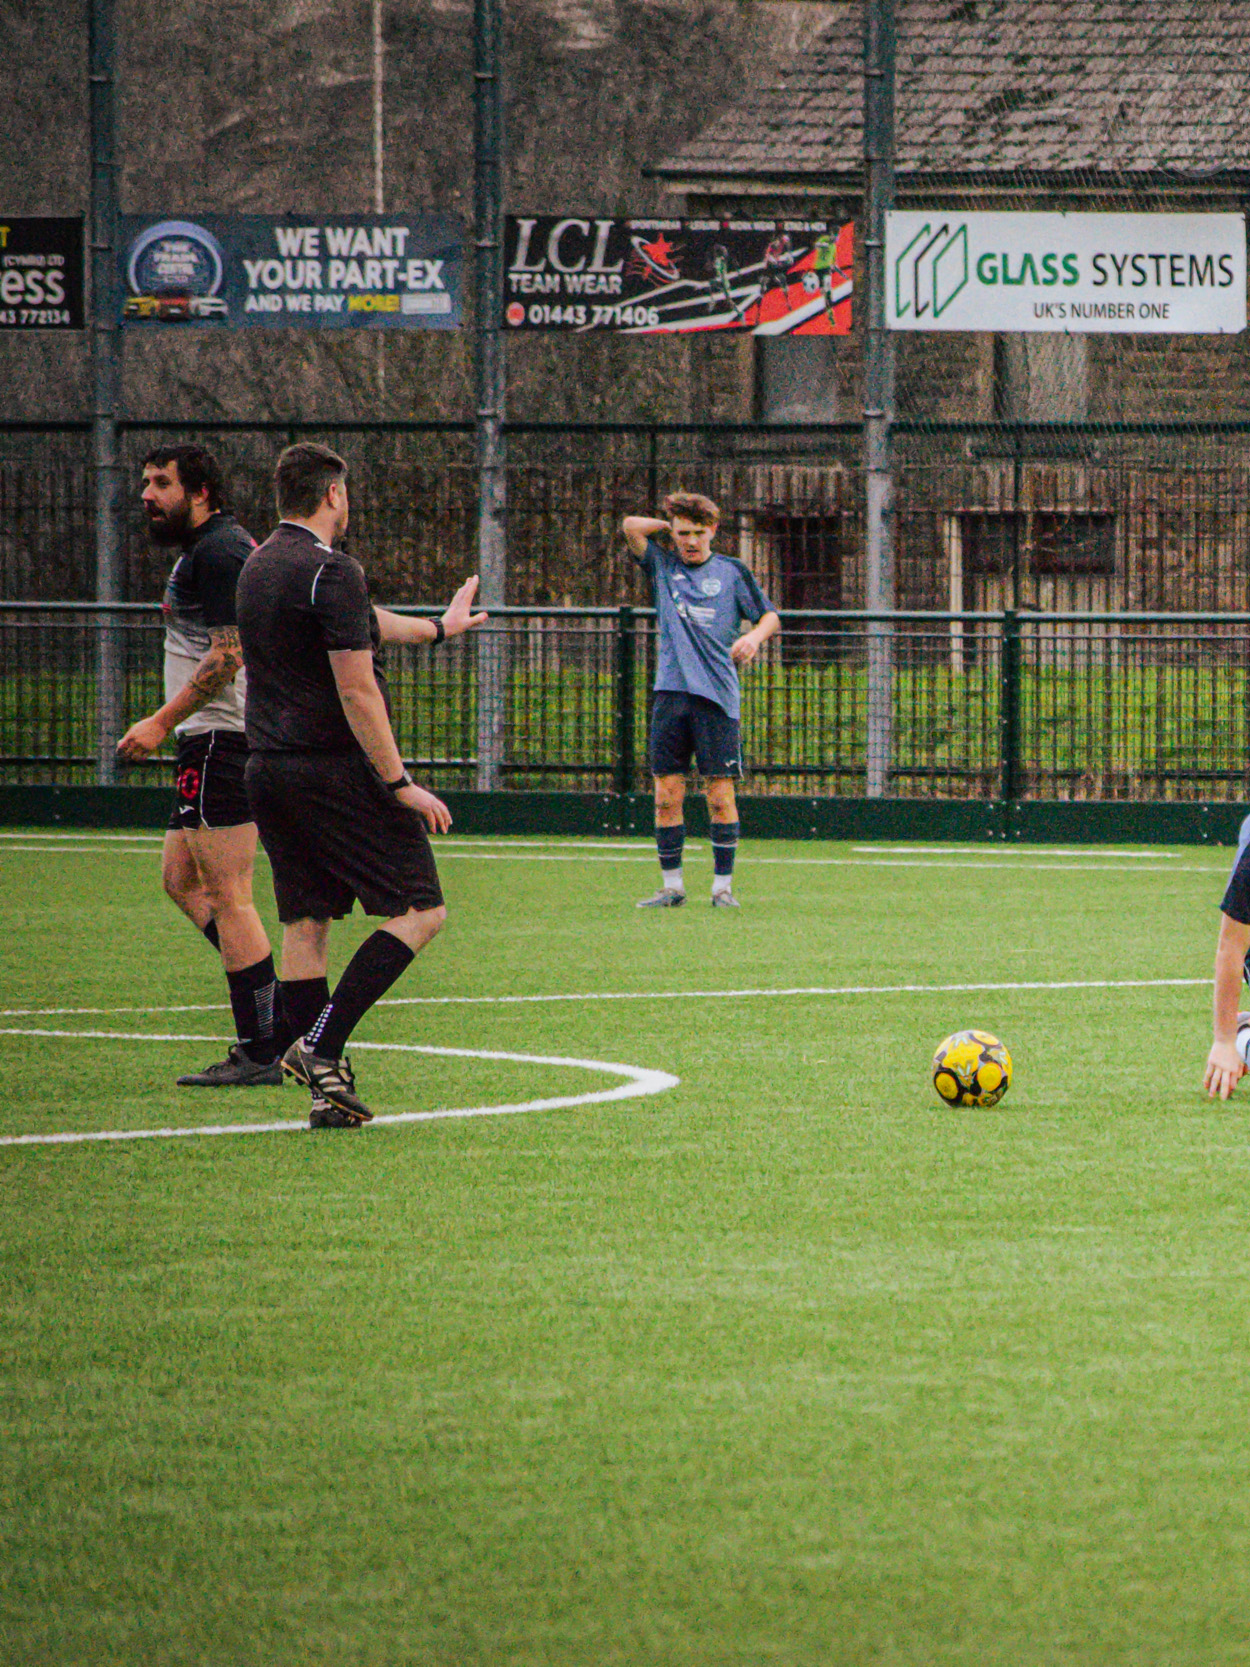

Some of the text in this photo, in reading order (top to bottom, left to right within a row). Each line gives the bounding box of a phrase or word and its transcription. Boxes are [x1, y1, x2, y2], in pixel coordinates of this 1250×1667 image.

[275, 226, 410, 257] WE WANT
[508, 218, 624, 274] LCL
[243, 258, 445, 290] YOUR PART-EX
[508, 273, 623, 295] TEAM WEAR
[976, 252, 1235, 288] GLASS SYSTEMS
[0, 269, 66, 305] ess
[245, 294, 283, 312] AND
[285, 294, 312, 312] WE
[314, 294, 345, 312] PAY
[528, 304, 660, 326] 01443 771406
[1033, 302, 1171, 319] UK'S NUMBER ONE
